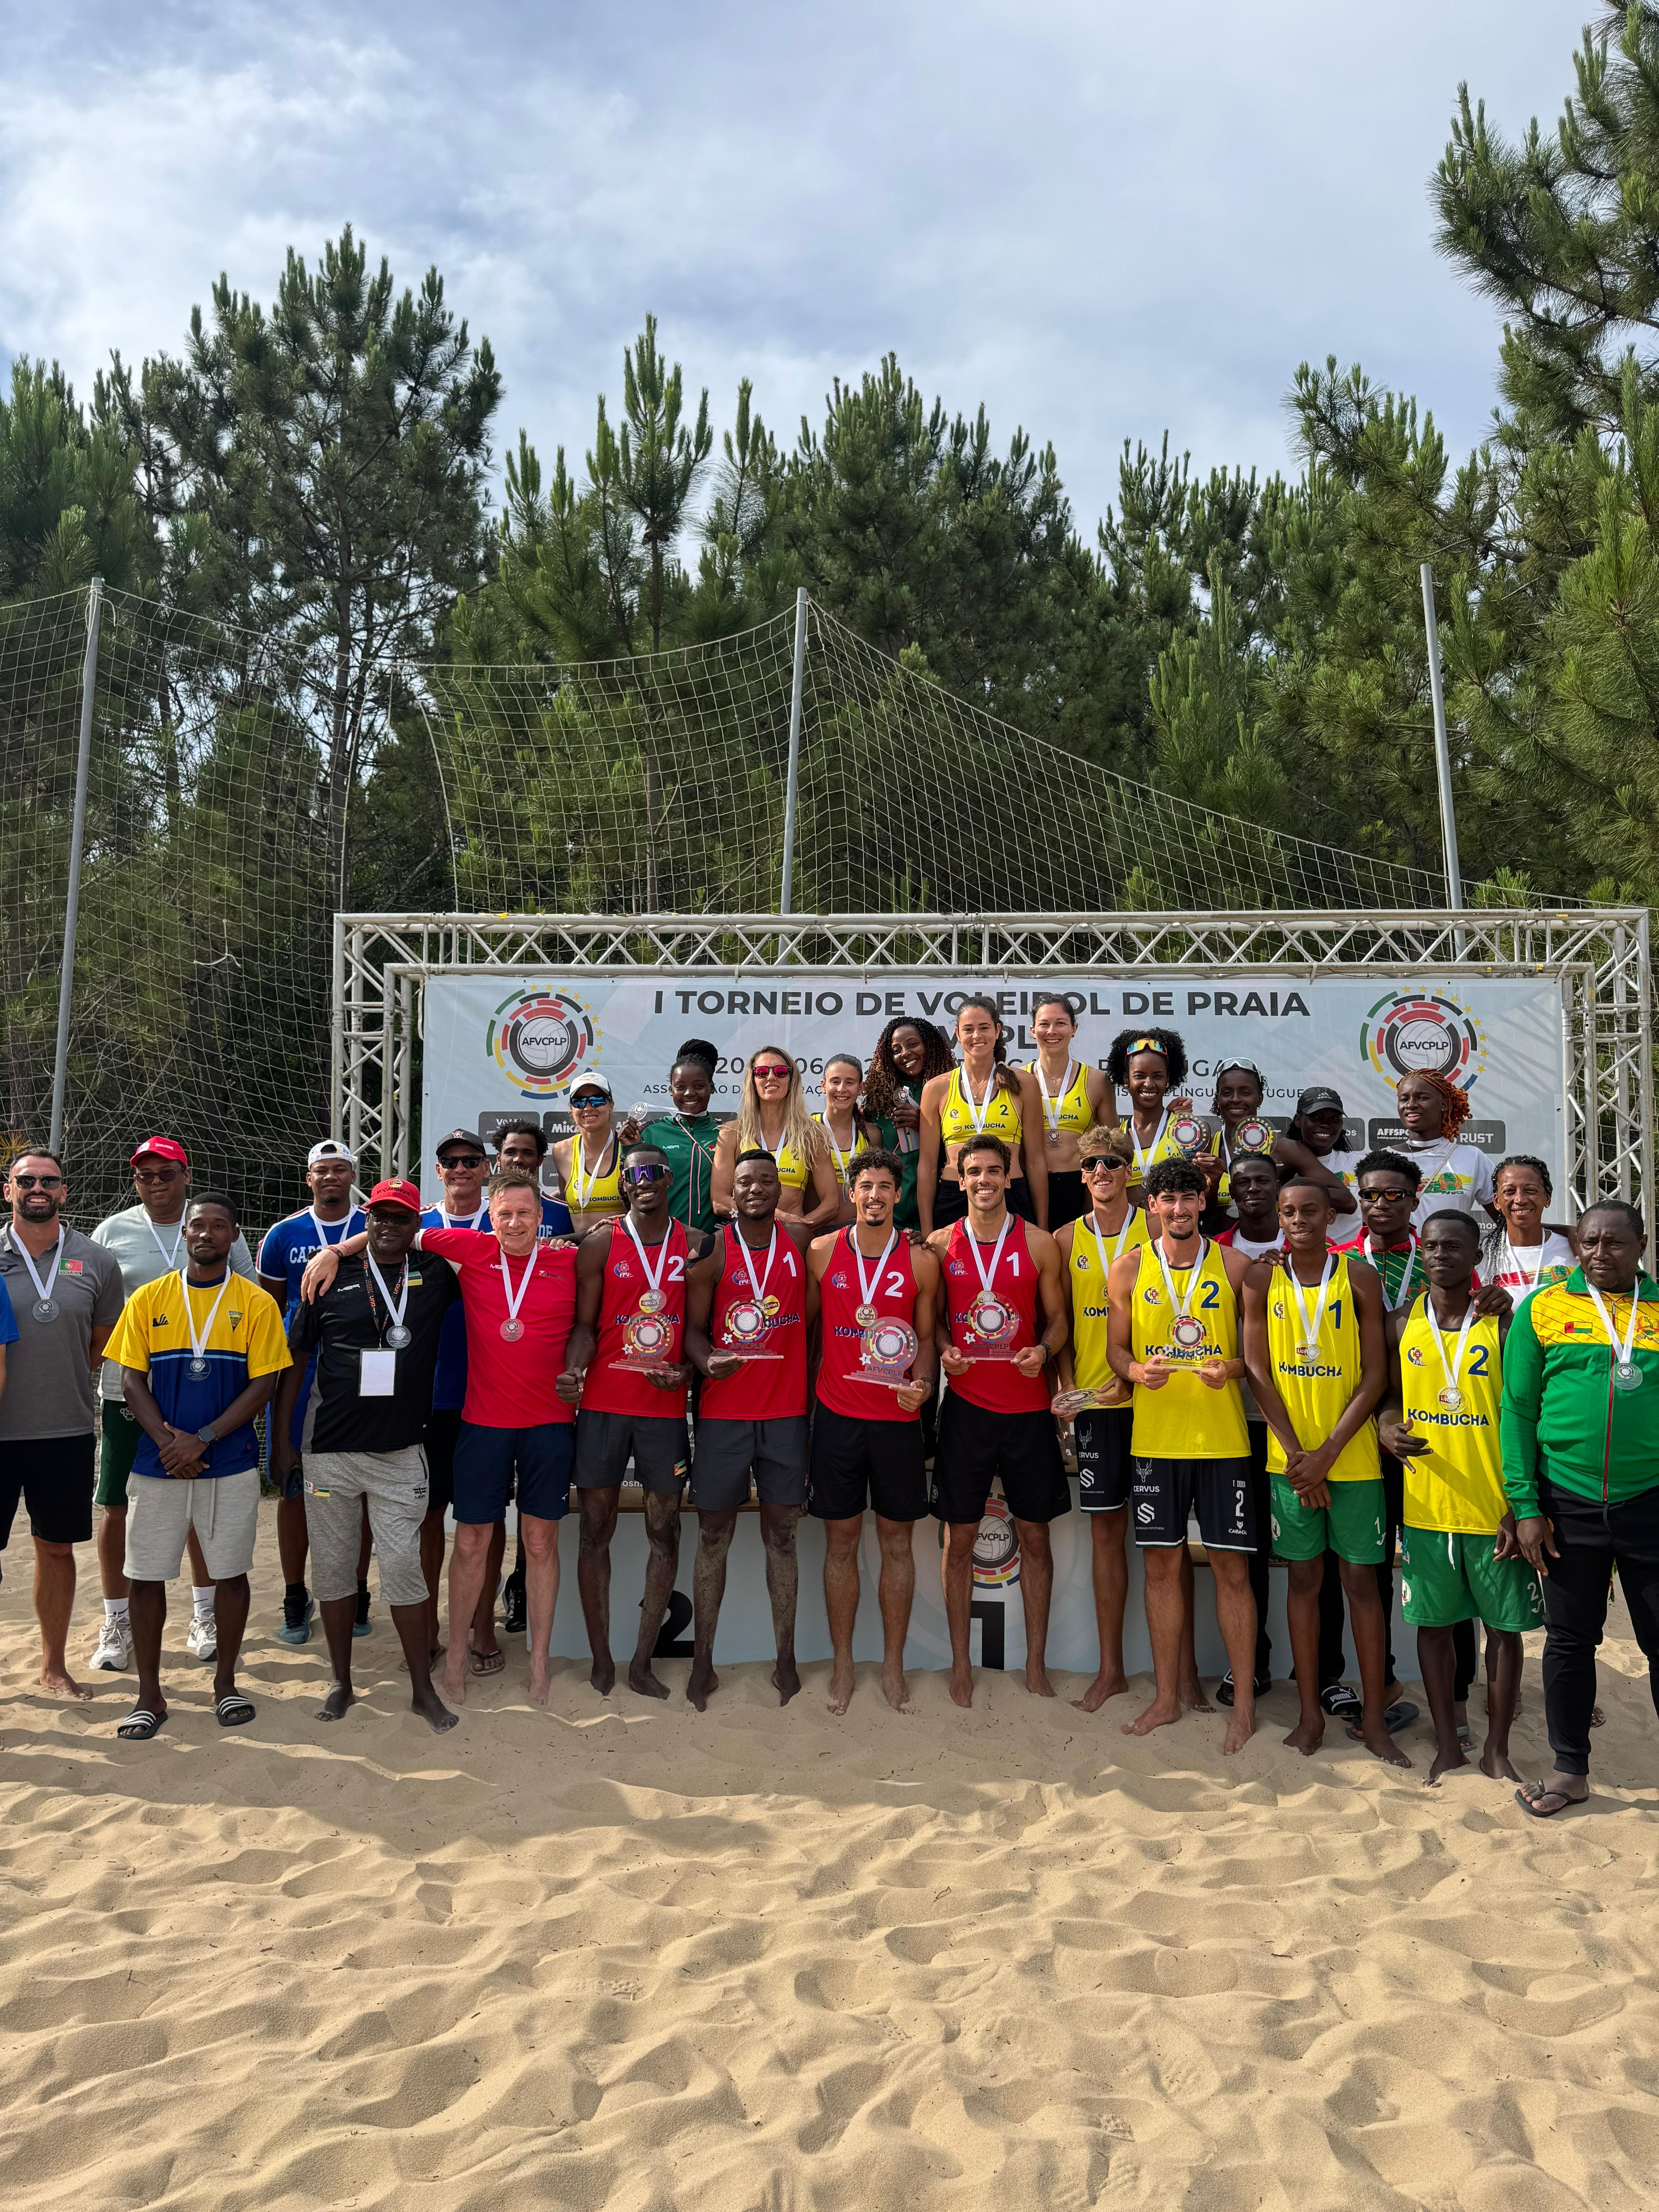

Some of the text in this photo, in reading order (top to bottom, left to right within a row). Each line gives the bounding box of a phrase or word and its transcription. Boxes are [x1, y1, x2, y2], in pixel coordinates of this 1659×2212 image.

[655, 990, 663, 1014] I
[675, 990, 843, 1016] TORNEIO
[856, 992, 905, 1016] DE
[1123, 992, 1173, 1016] DE
[1188, 992, 1310, 1017] PRAIA
[521, 1037, 567, 1046] AFVCPLP
[1399, 1041, 1449, 1051] AFVCPLP
[999, 1104, 1009, 1116] 2
[1075, 1096, 1081, 1107] 1
[667, 1255, 685, 1281] 2
[782, 1251, 797, 1277] 1
[1006, 1252, 1020, 1277] 1
[884, 1271, 905, 1298] 2
[1200, 1280, 1220, 1309] 2
[1328, 1299, 1342, 1329] 1
[1468, 1344, 1489, 1376] 2
[1408, 1408, 1490, 1426] KOMBUCHA
[1236, 1490, 1244, 1517] 2
[1374, 1517, 1381, 1535] 1
[1527, 1582, 1539, 1602] 2
[639, 1590, 695, 1659] 2
[1329, 1693, 1352, 1703] PUMA
